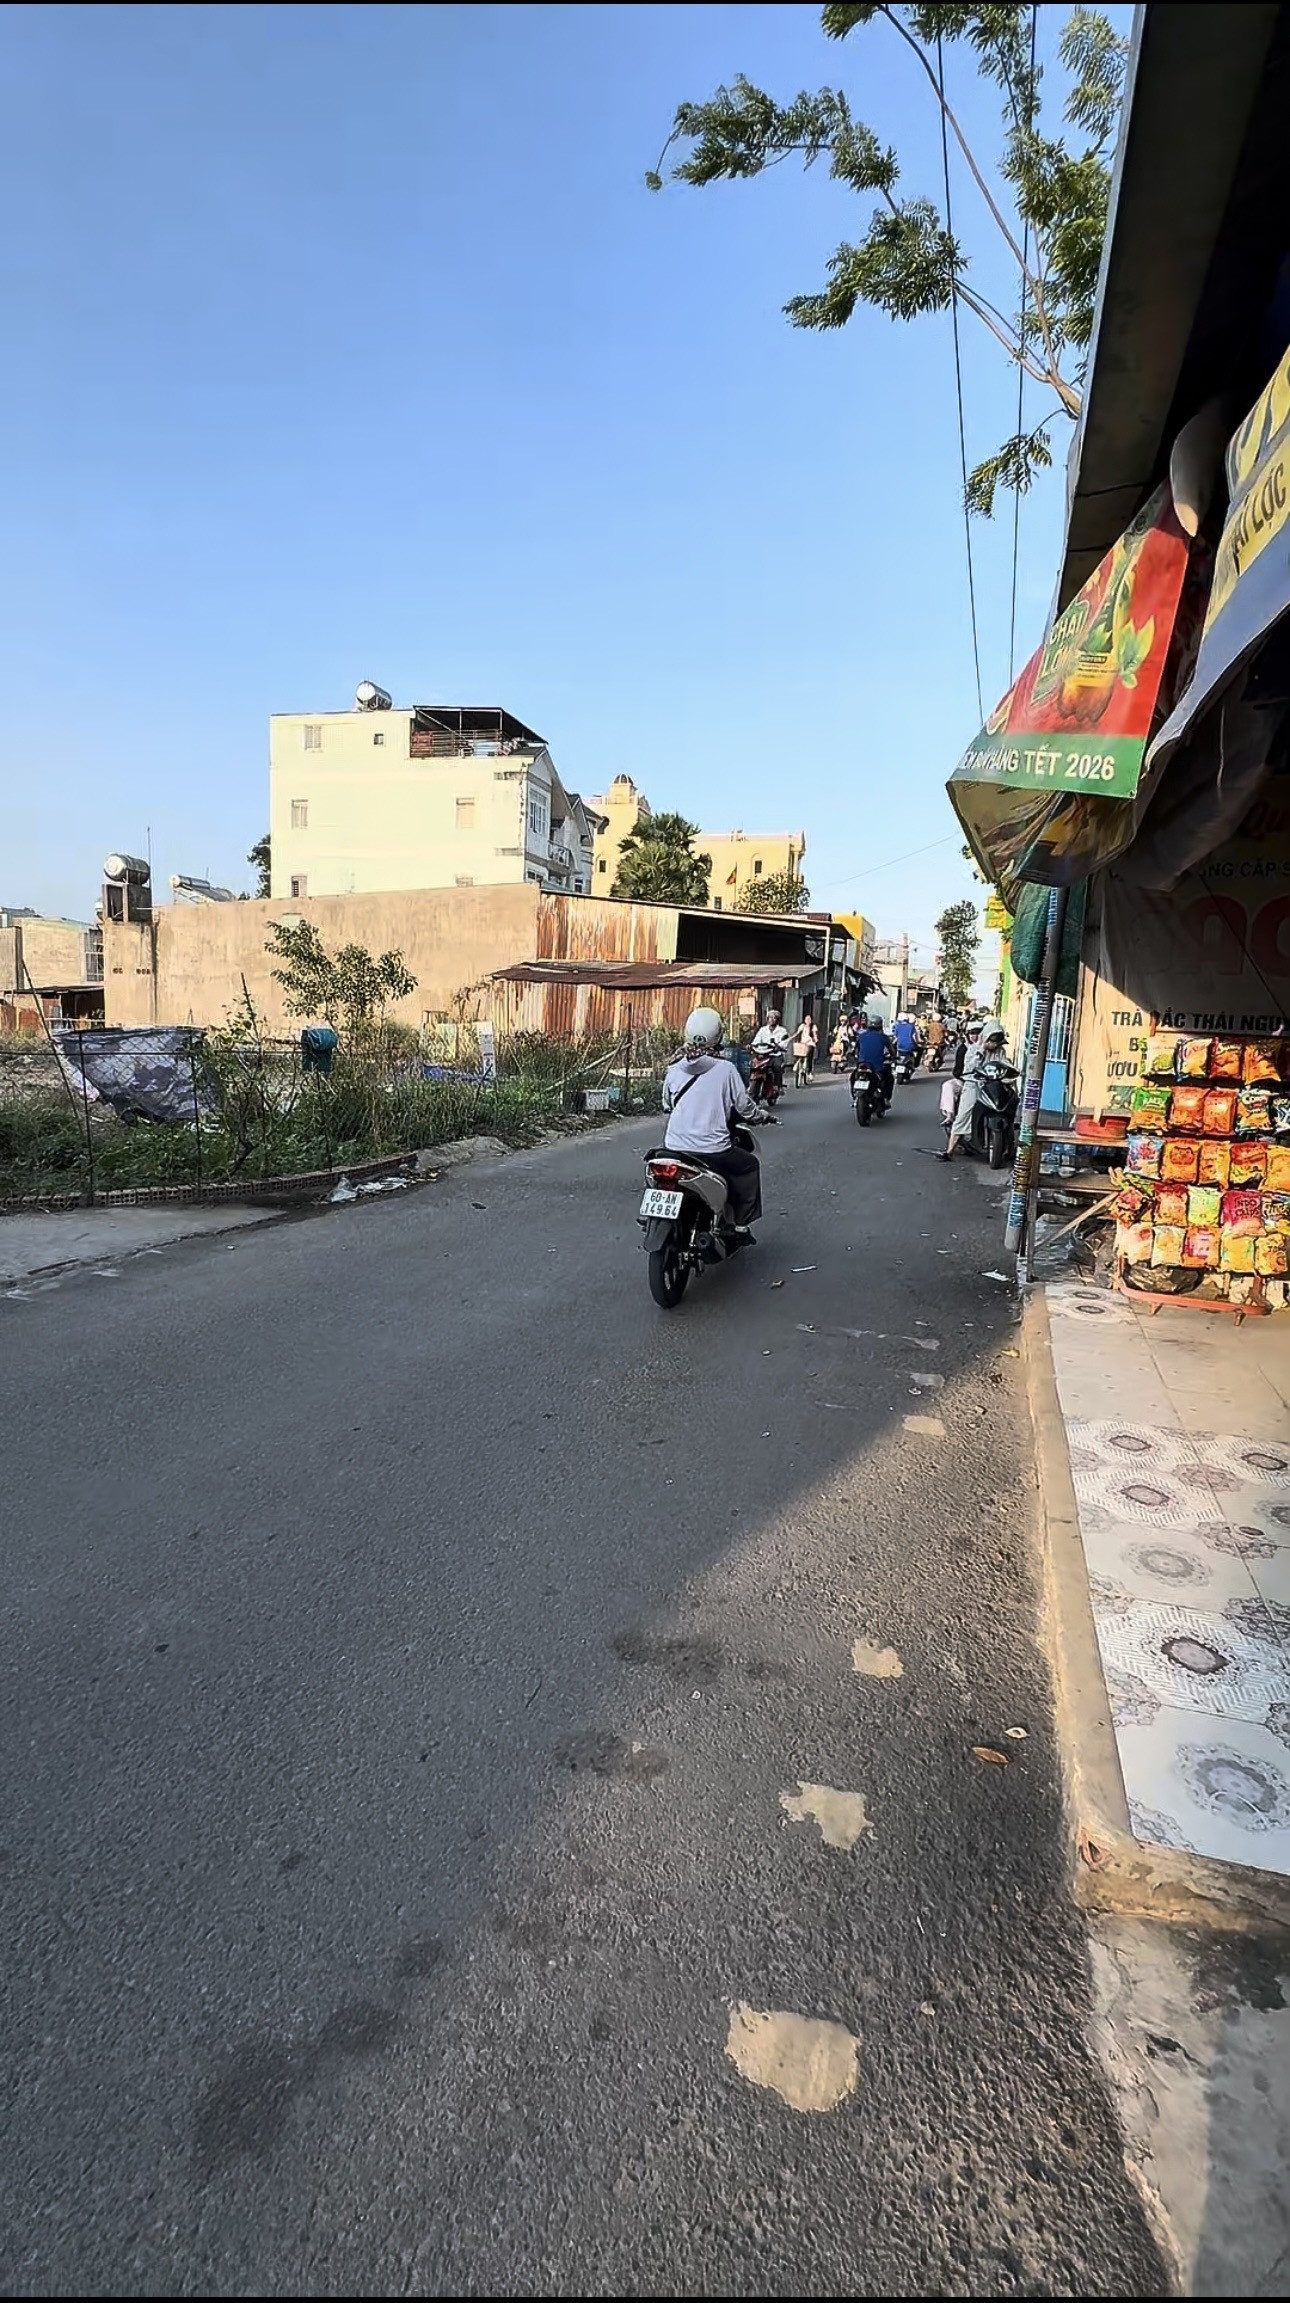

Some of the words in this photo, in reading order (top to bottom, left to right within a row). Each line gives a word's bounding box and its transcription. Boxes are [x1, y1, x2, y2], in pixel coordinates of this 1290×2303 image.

[1024, 742, 1062, 776] TẾT
[1065, 752, 1115, 781] 2026
[1111, 1008, 1143, 1027] TRÀ
[1192, 1011, 1234, 1030] THÁI
[1107, 1060, 1138, 1080] ƯỢU
